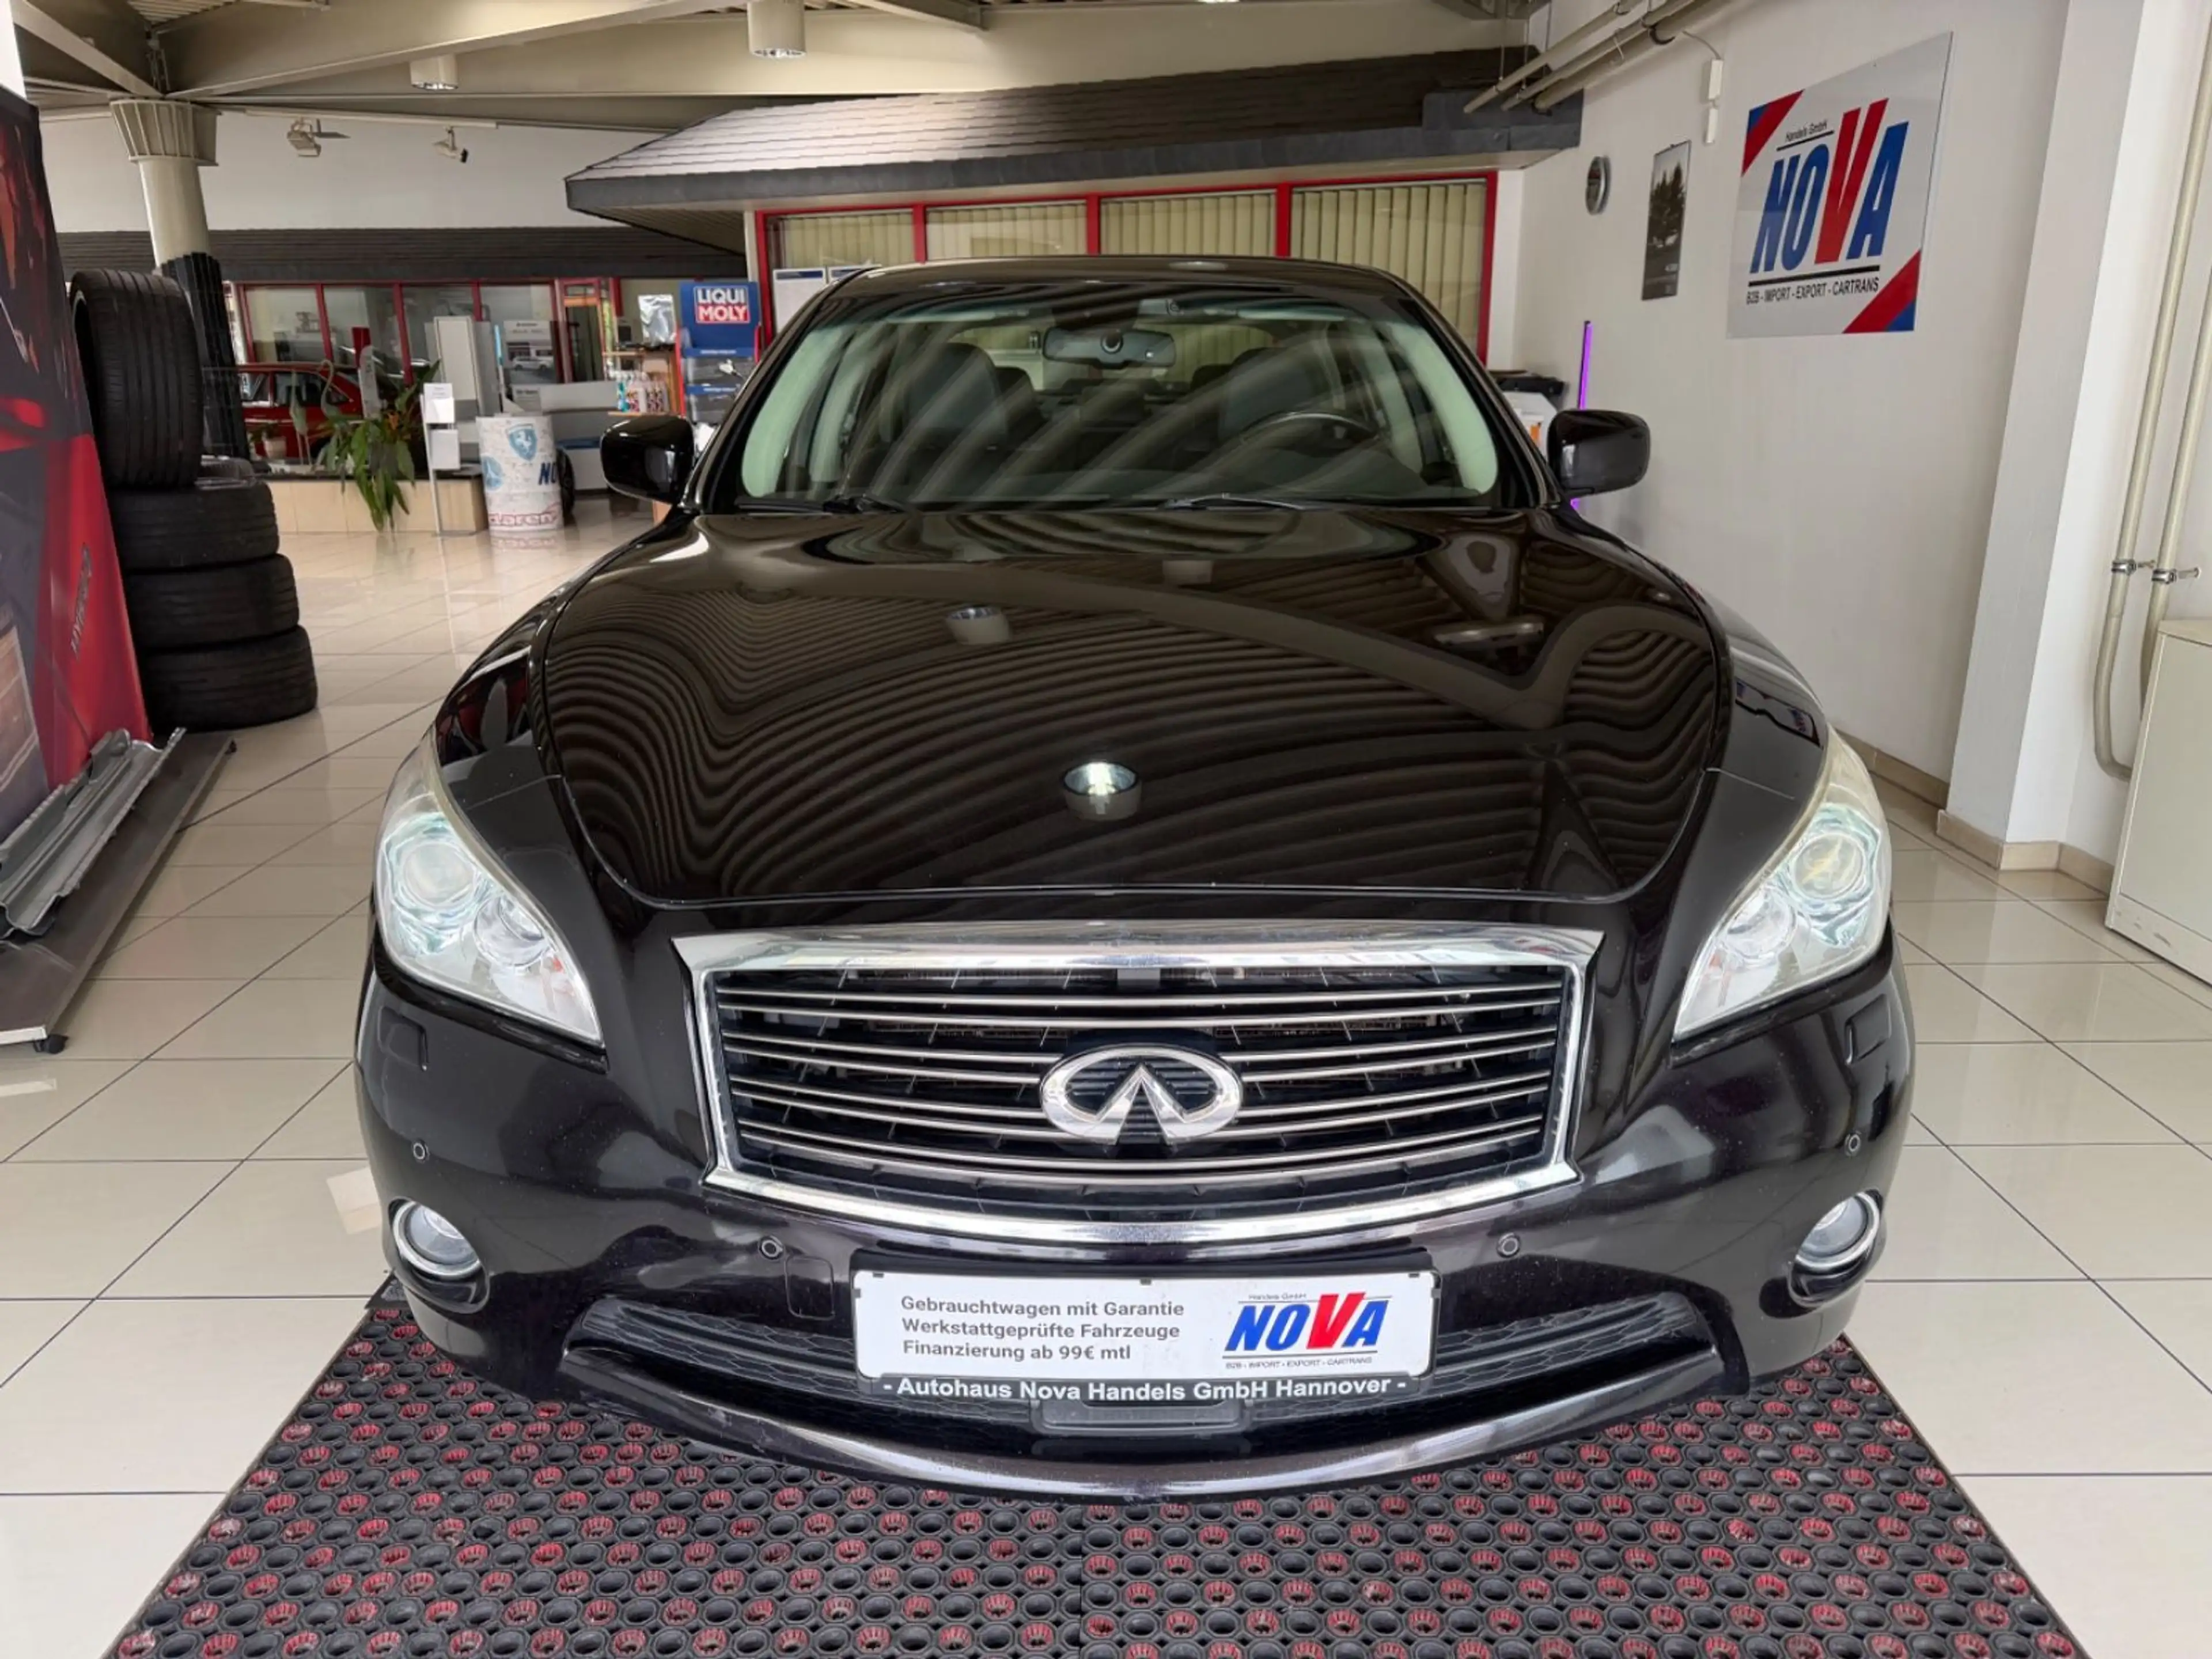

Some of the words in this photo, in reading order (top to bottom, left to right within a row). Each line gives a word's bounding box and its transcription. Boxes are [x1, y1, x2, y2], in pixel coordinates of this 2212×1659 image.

[1809, 118, 1828, 136] GmbH
[1749, 98, 1909, 274] NOVA
[697, 288, 745, 305] LIQUI
[1764, 287, 1791, 302] IMPORT
[1796, 282, 1827, 299] EXPORT
[1832, 276, 1880, 296] CARTRANS
[699, 306, 748, 324] MOLY
[901, 1296, 1061, 1318] Gebrauchtwagen
[1067, 1301, 1097, 1316] mit
[1104, 1301, 1184, 1316] Garantie
[902, 1318, 1074, 1340] Werkstattgeprüfte
[1080, 1324, 1180, 1340] Fahrzeuge
[1225, 1292, 1389, 1351] NOVA
[903, 1340, 1025, 1362] Finanzierung
[1030, 1345, 1053, 1359] ab
[1059, 1346, 1094, 1359] 99€
[1100, 1345, 1131, 1359] mtl
[1248, 1361, 1281, 1369] IMPORT
[1287, 1359, 1320, 1368] EXPORT
[1327, 1357, 1372, 1366] CARTRANS
[897, 1378, 1012, 1397] Autohaus
[1020, 1382, 1081, 1399] Nova
[1088, 1382, 1185, 1400] Handels
[1194, 1380, 1267, 1399] GmbH
[1275, 1379, 1392, 1397] Hannover
